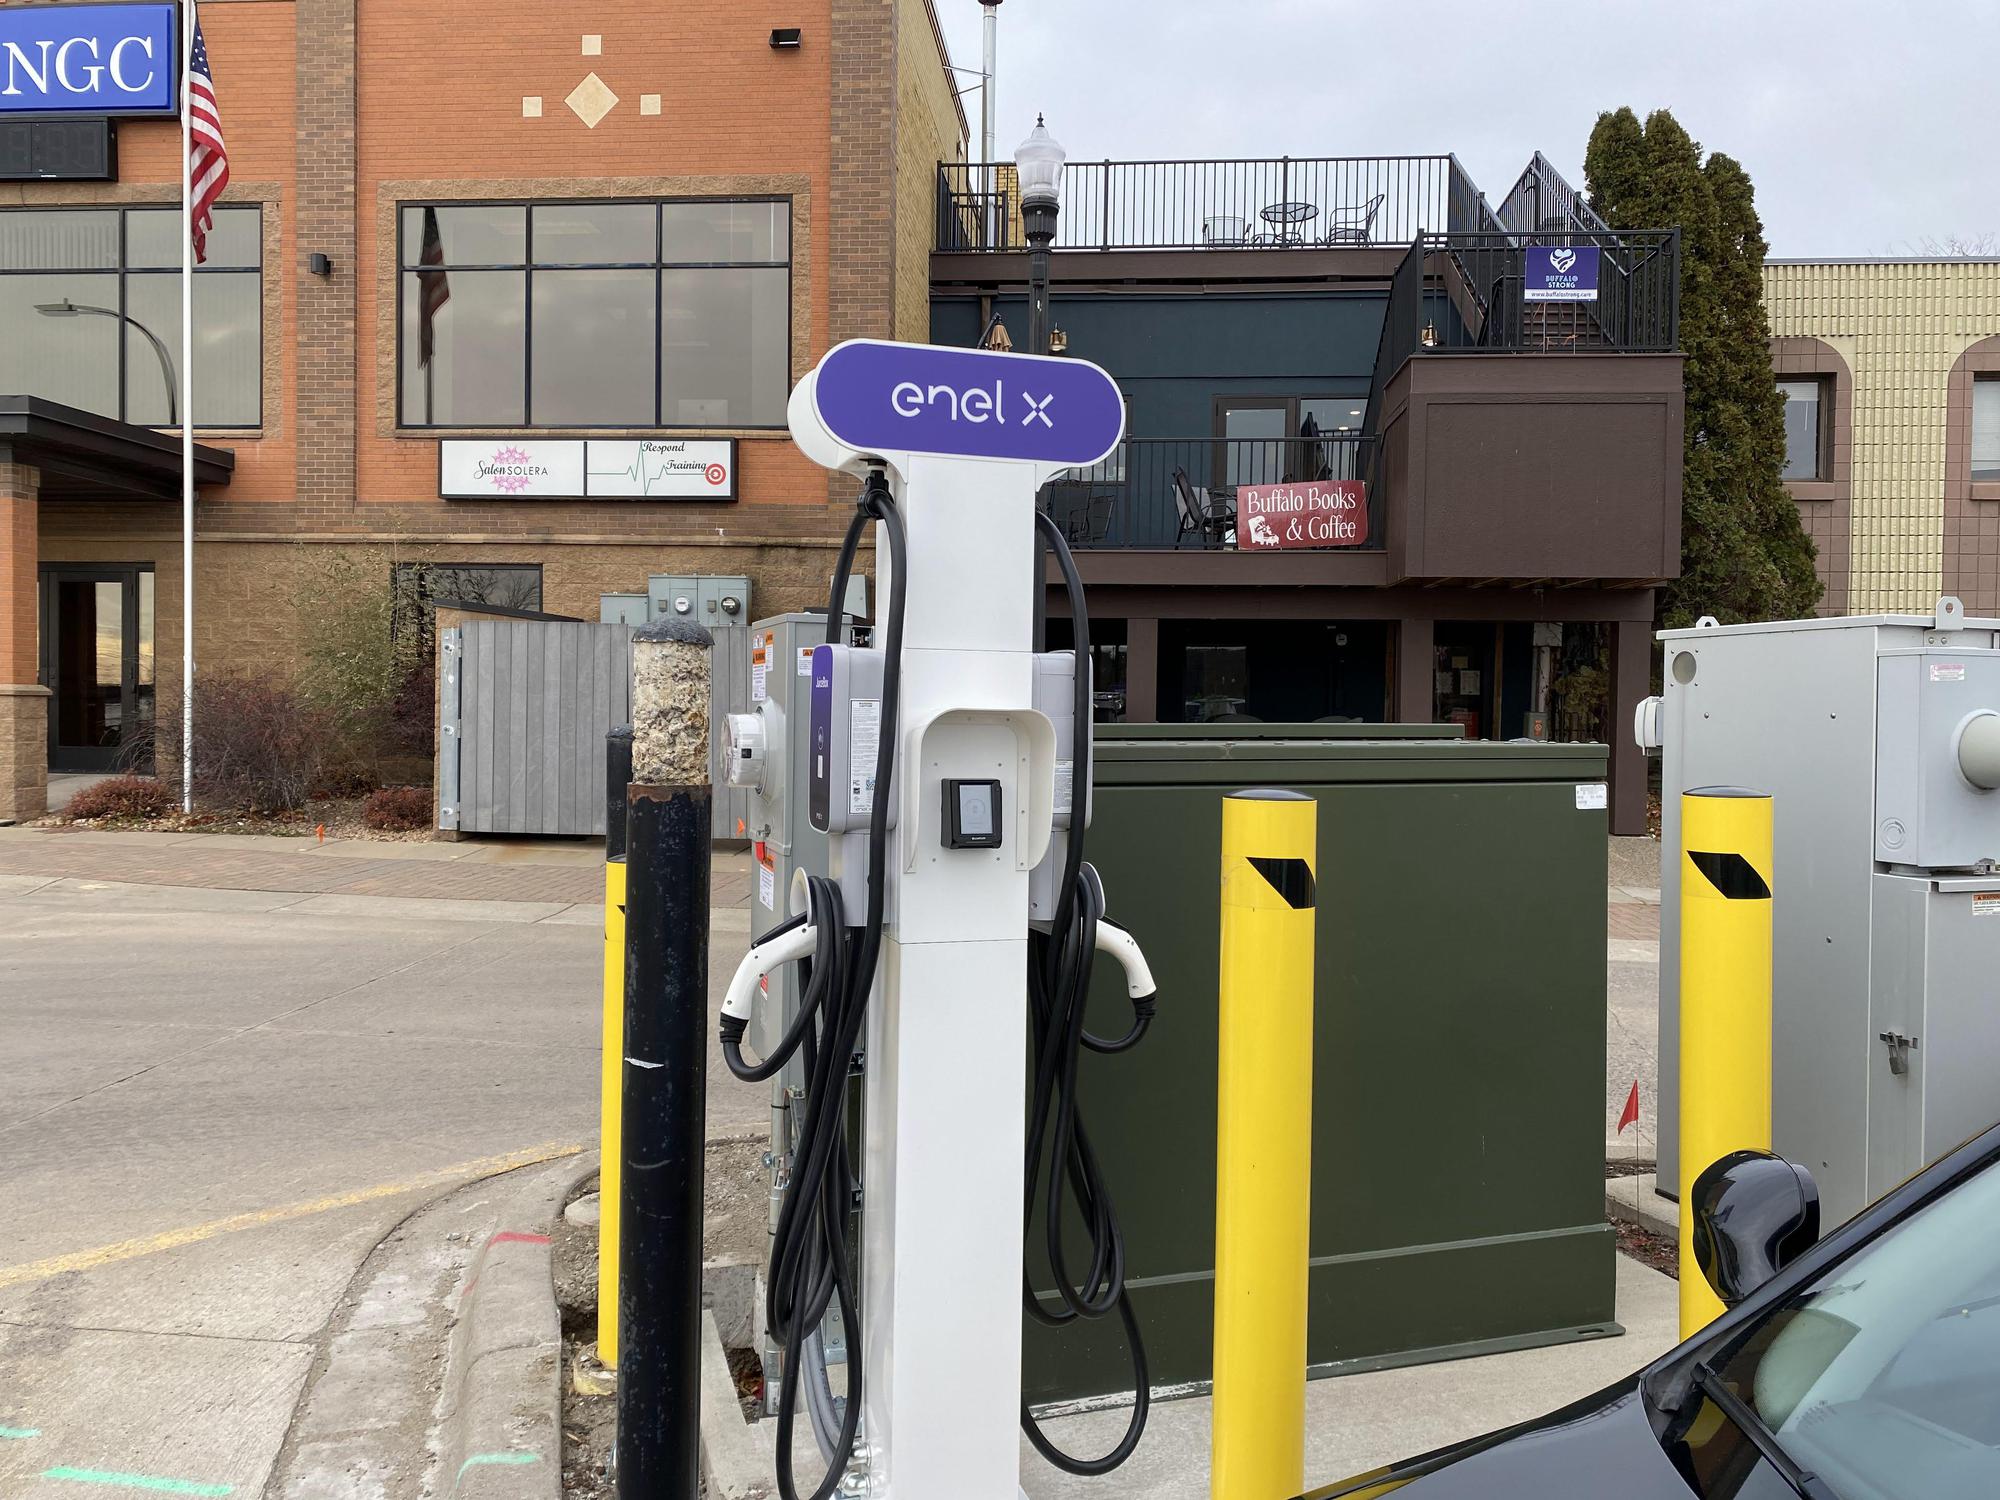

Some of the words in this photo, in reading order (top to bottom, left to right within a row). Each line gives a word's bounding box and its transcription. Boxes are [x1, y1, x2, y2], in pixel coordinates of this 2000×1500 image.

[2, 36, 153, 95] NGC
[891, 379, 1006, 424] enel
[642, 441, 685, 454] Respond
[666, 459, 707, 472] Training
[1247, 488, 1304, 514] Buffalo
[1308, 486, 1356, 511] Books
[1286, 517, 1304, 541] &
[1308, 514, 1357, 540] Coffee
